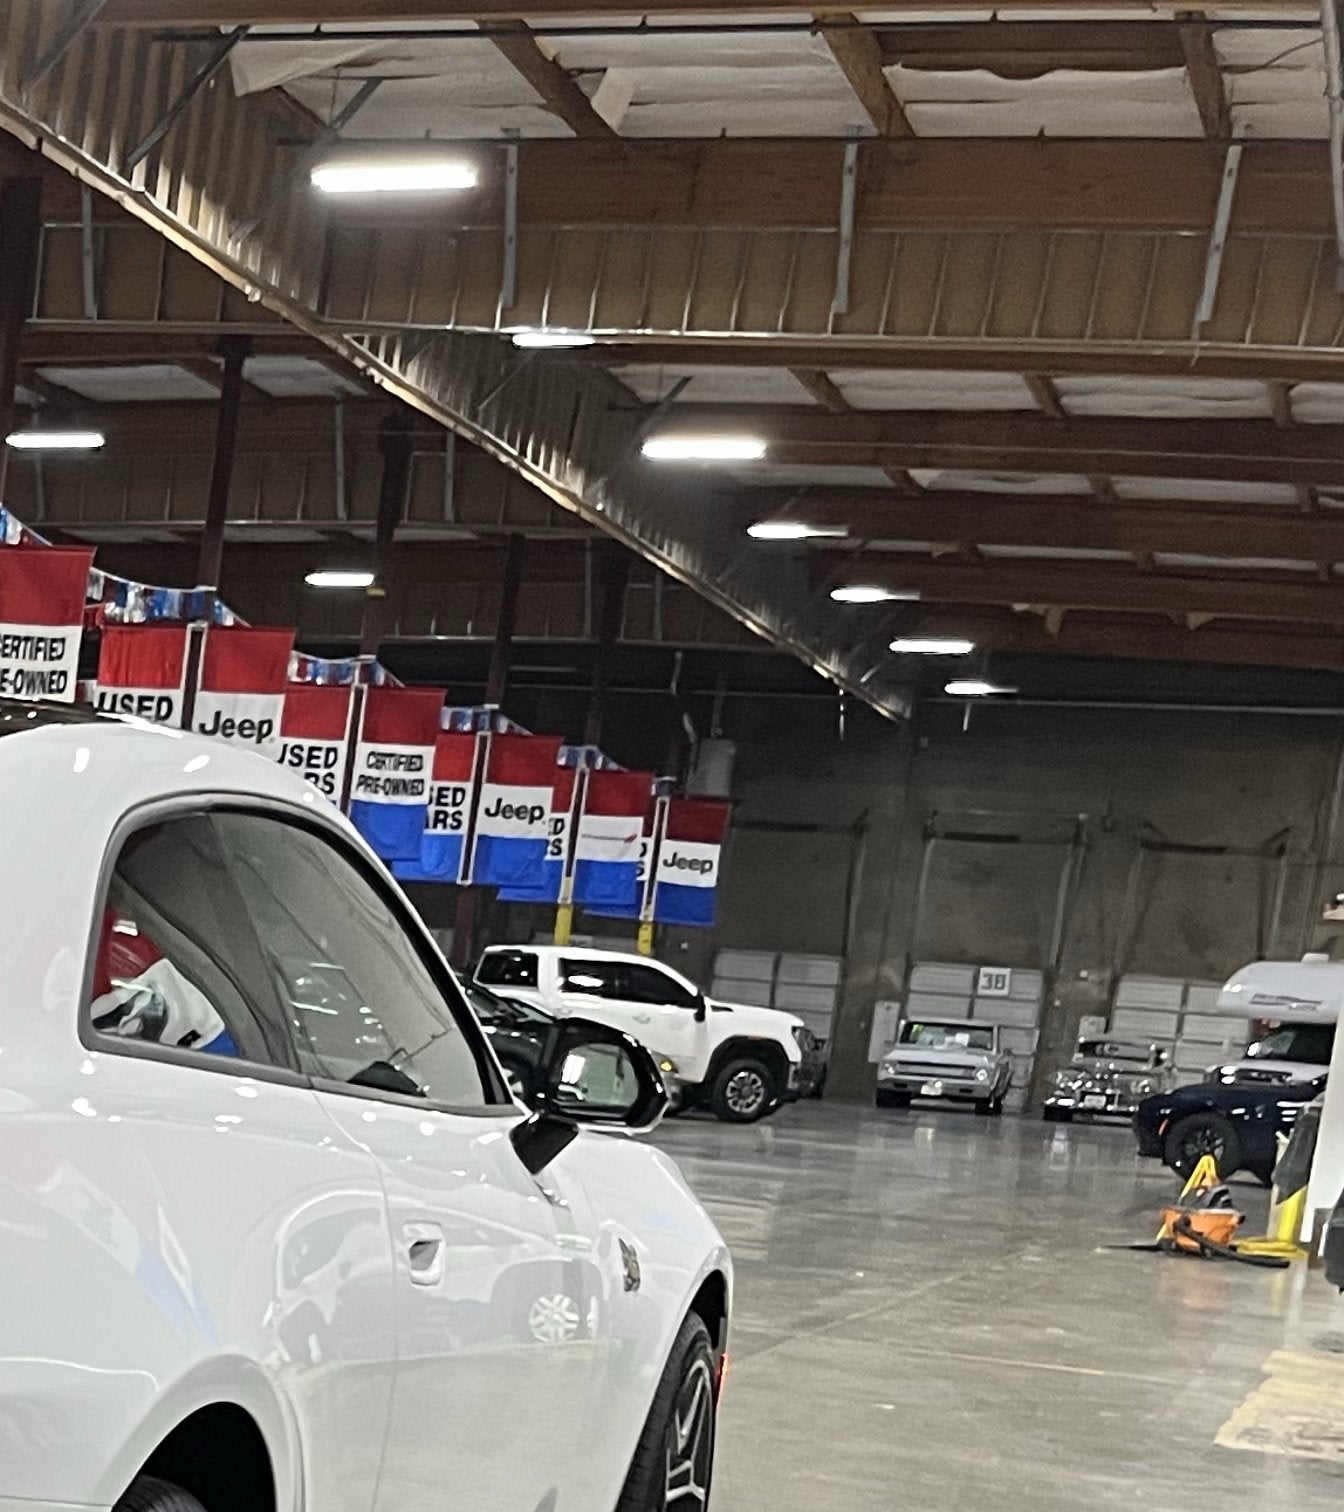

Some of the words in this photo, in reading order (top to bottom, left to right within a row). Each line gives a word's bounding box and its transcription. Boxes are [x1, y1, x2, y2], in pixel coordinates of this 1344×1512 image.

[198, 710, 274, 744] Jeep
[484, 797, 545, 825] Jeep
[662, 852, 713, 875] Jeep
